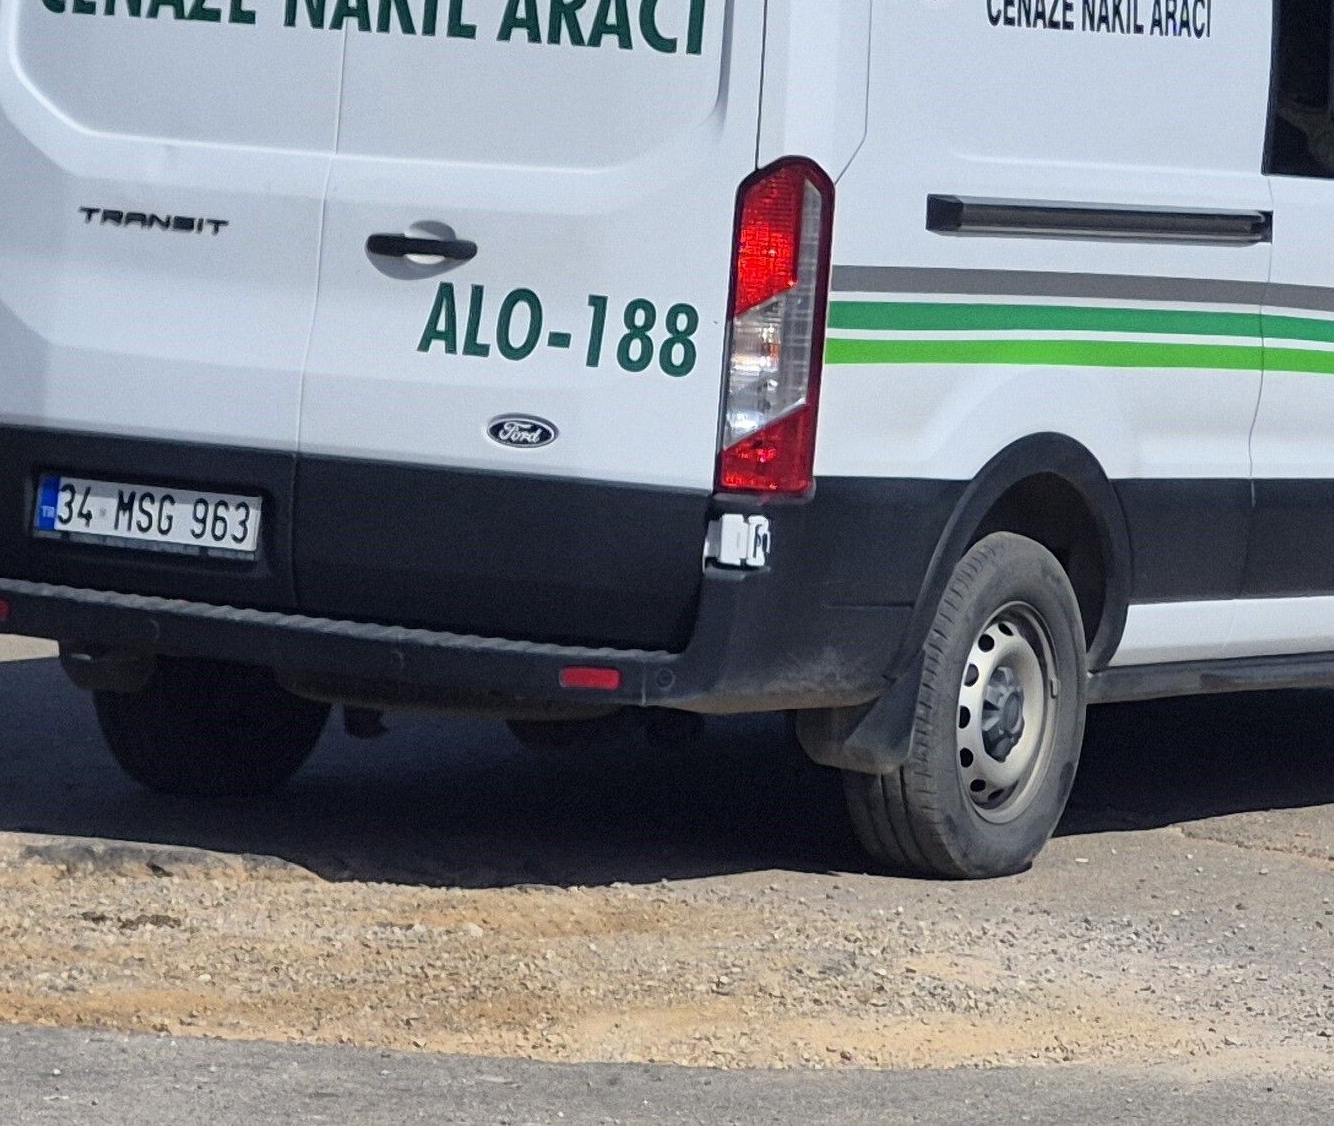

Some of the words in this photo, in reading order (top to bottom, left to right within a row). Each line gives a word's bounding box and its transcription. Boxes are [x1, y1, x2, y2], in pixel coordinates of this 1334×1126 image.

[78, 205, 230, 237] TRANSIT
[417, 281, 699, 378] ALO-188
[498, 422, 543, 443] Ford
[58, 483, 93, 527] 34
[114, 489, 176, 536] MSG
[190, 497, 250, 544] 963
